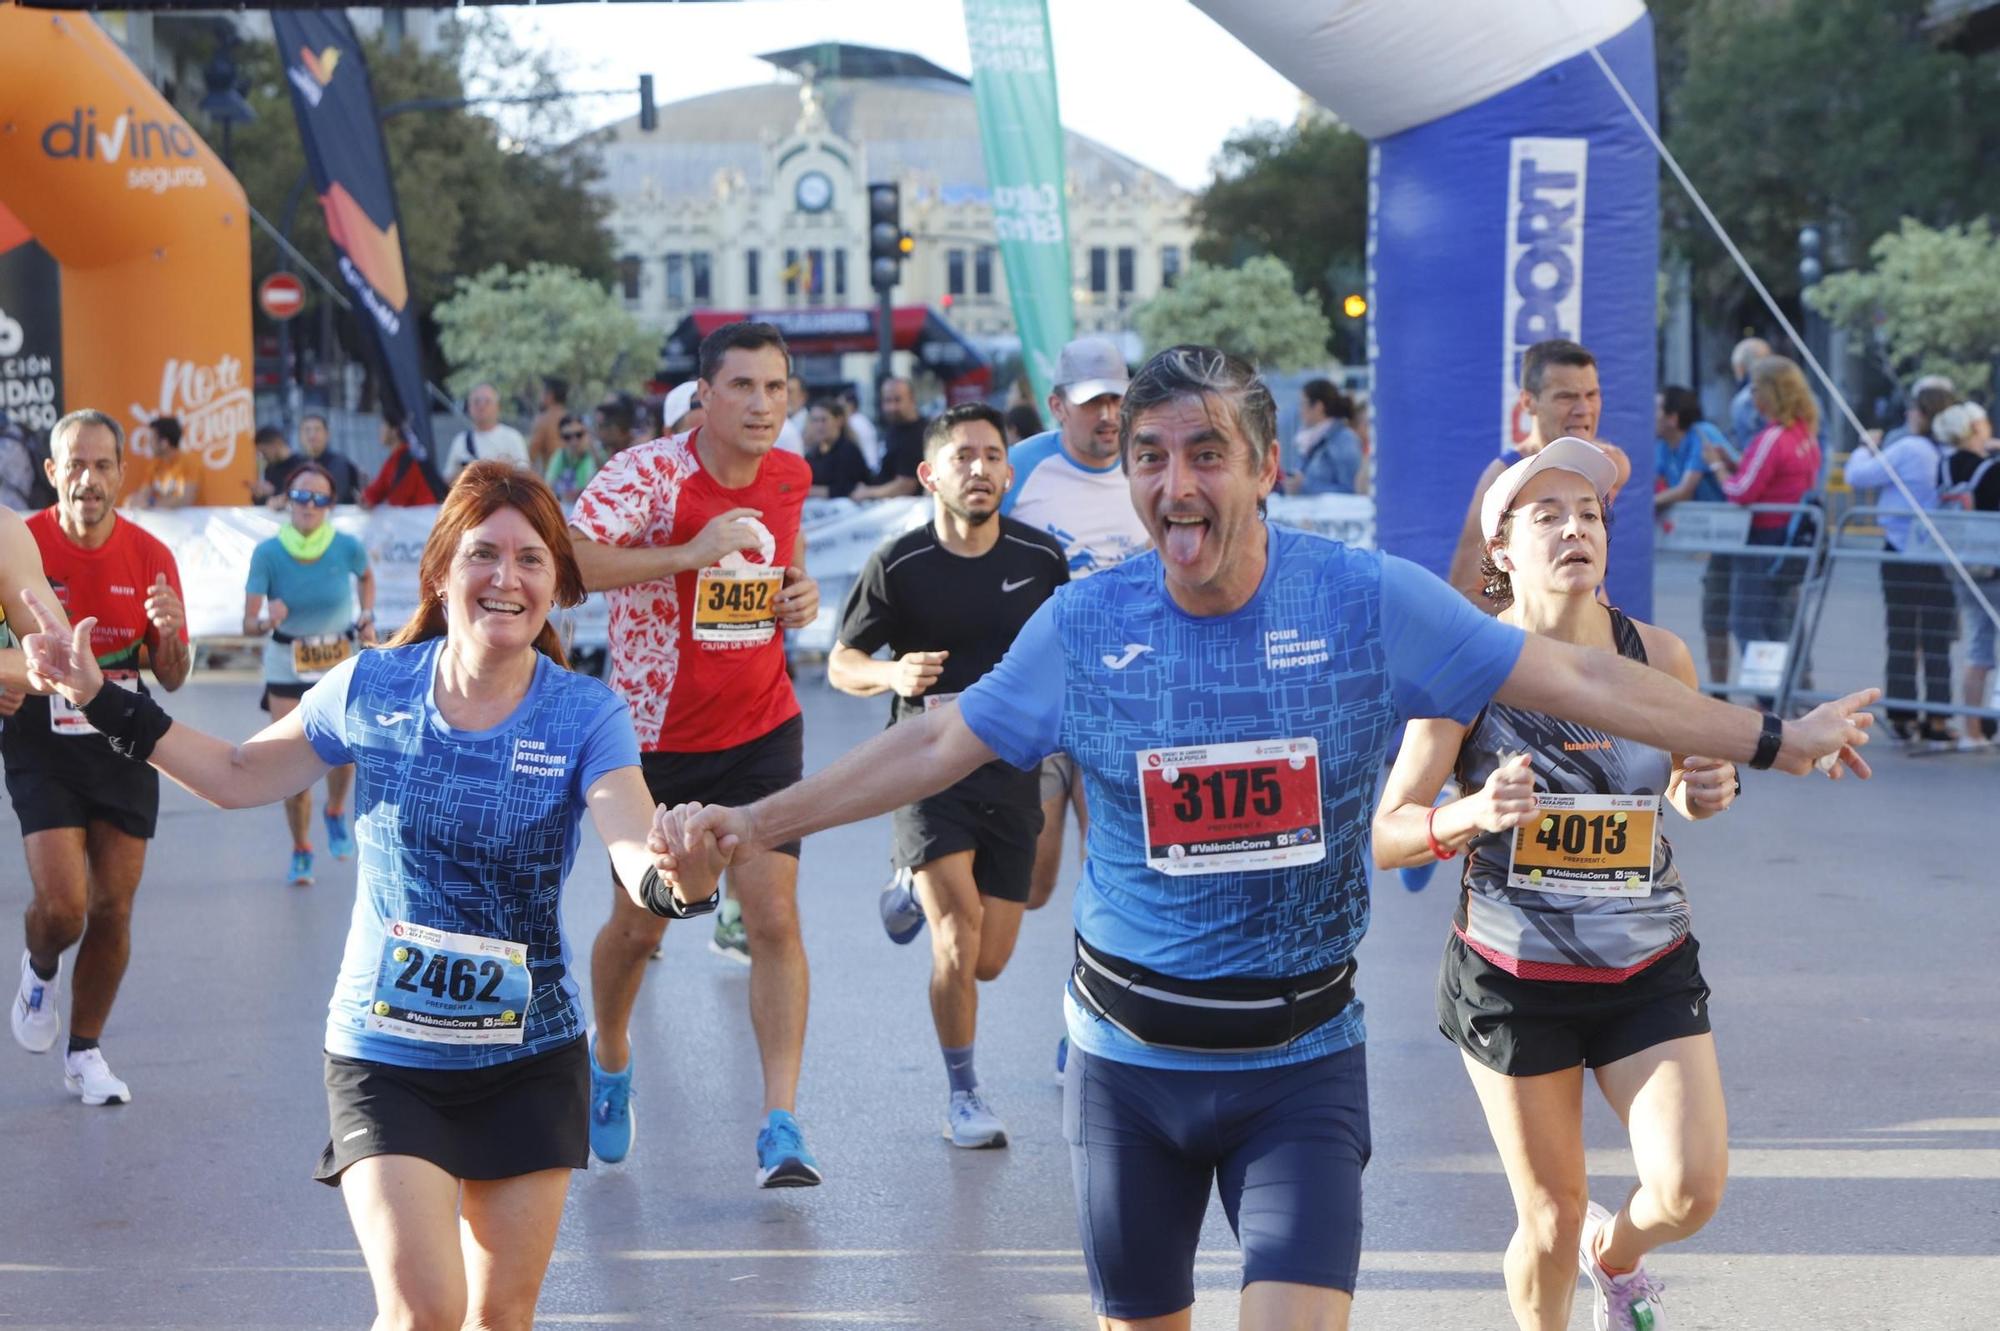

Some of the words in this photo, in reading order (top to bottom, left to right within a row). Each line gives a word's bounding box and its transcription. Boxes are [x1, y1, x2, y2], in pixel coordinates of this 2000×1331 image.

[41, 106, 198, 163] divina
[127, 166, 207, 194] seguros
[0, 354, 52, 379] CIÓN
[708, 581, 768, 611] 3452
[1269, 629, 1299, 641] CLUB
[1270, 638, 1327, 655] ATLETISME
[1271, 652, 1329, 669] PAIPORTA
[519, 740, 545, 750] CLUB
[517, 751, 567, 765] ATLETISME
[515, 763, 565, 777] PAIPORTA
[1172, 767, 1282, 823] 3175
[1536, 814, 1628, 855] 4013
[1190, 839, 1271, 854] #ValènciaCorre
[1563, 856, 1600, 864] PREFERENT
[1546, 868, 1609, 880] #ValènciaCorre
[395, 946, 504, 1003] 2462
[425, 999, 466, 1010] PREFERENT
[406, 1012, 478, 1028] #ValènciaCorre
